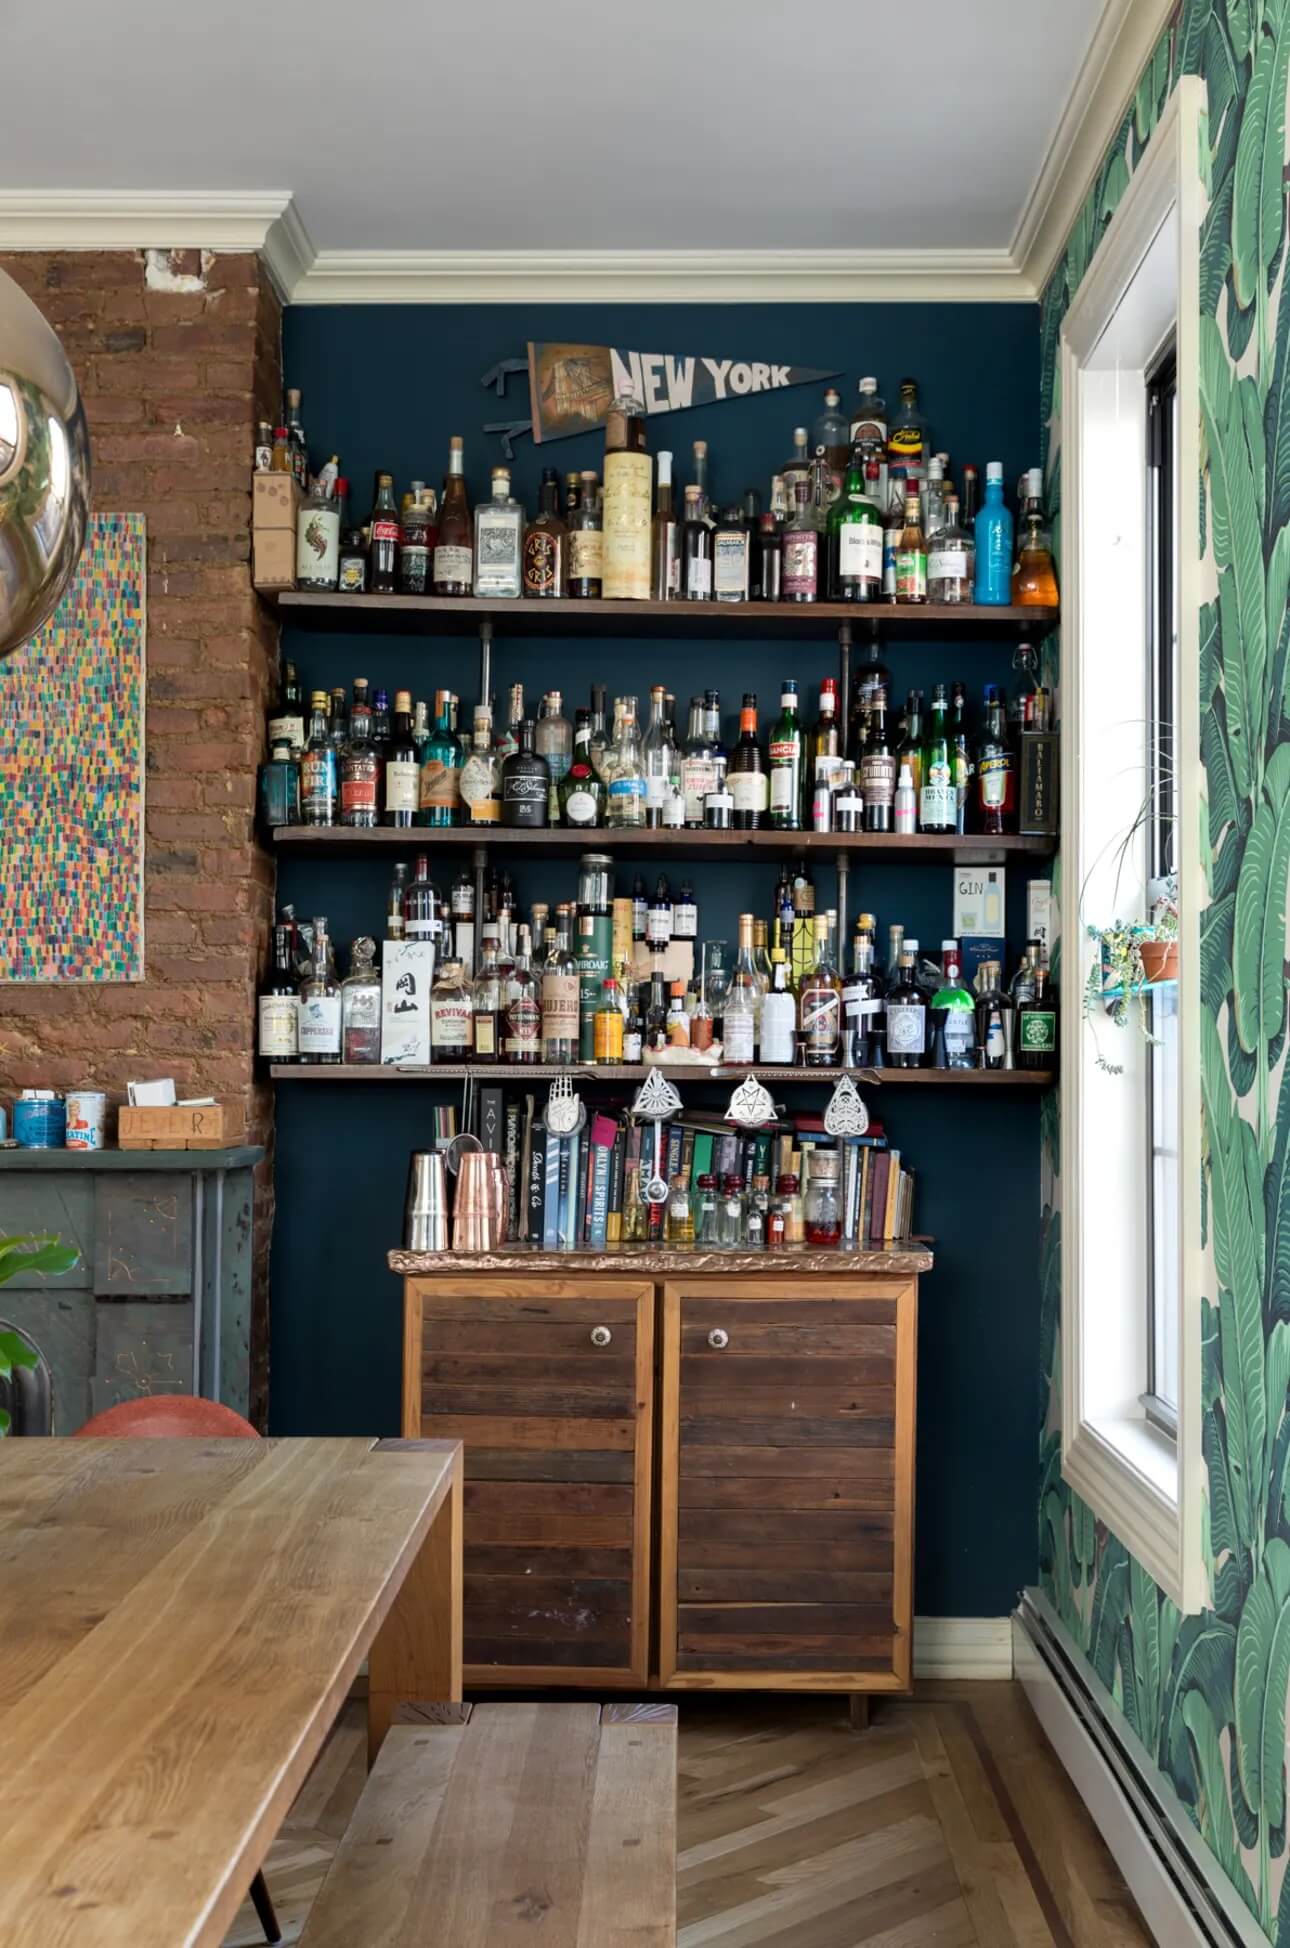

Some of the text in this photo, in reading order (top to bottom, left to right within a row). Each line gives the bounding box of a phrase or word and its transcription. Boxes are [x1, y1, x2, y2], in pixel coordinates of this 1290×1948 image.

[610, 348, 792, 414] NEW YORK
[959, 881, 983, 895] GIN
[434, 1007, 473, 1020] REVIVAL
[487, 1108, 496, 1149] AVI
[530, 1183, 541, 1193] &
[593, 1184, 606, 1223] SPIRITS
